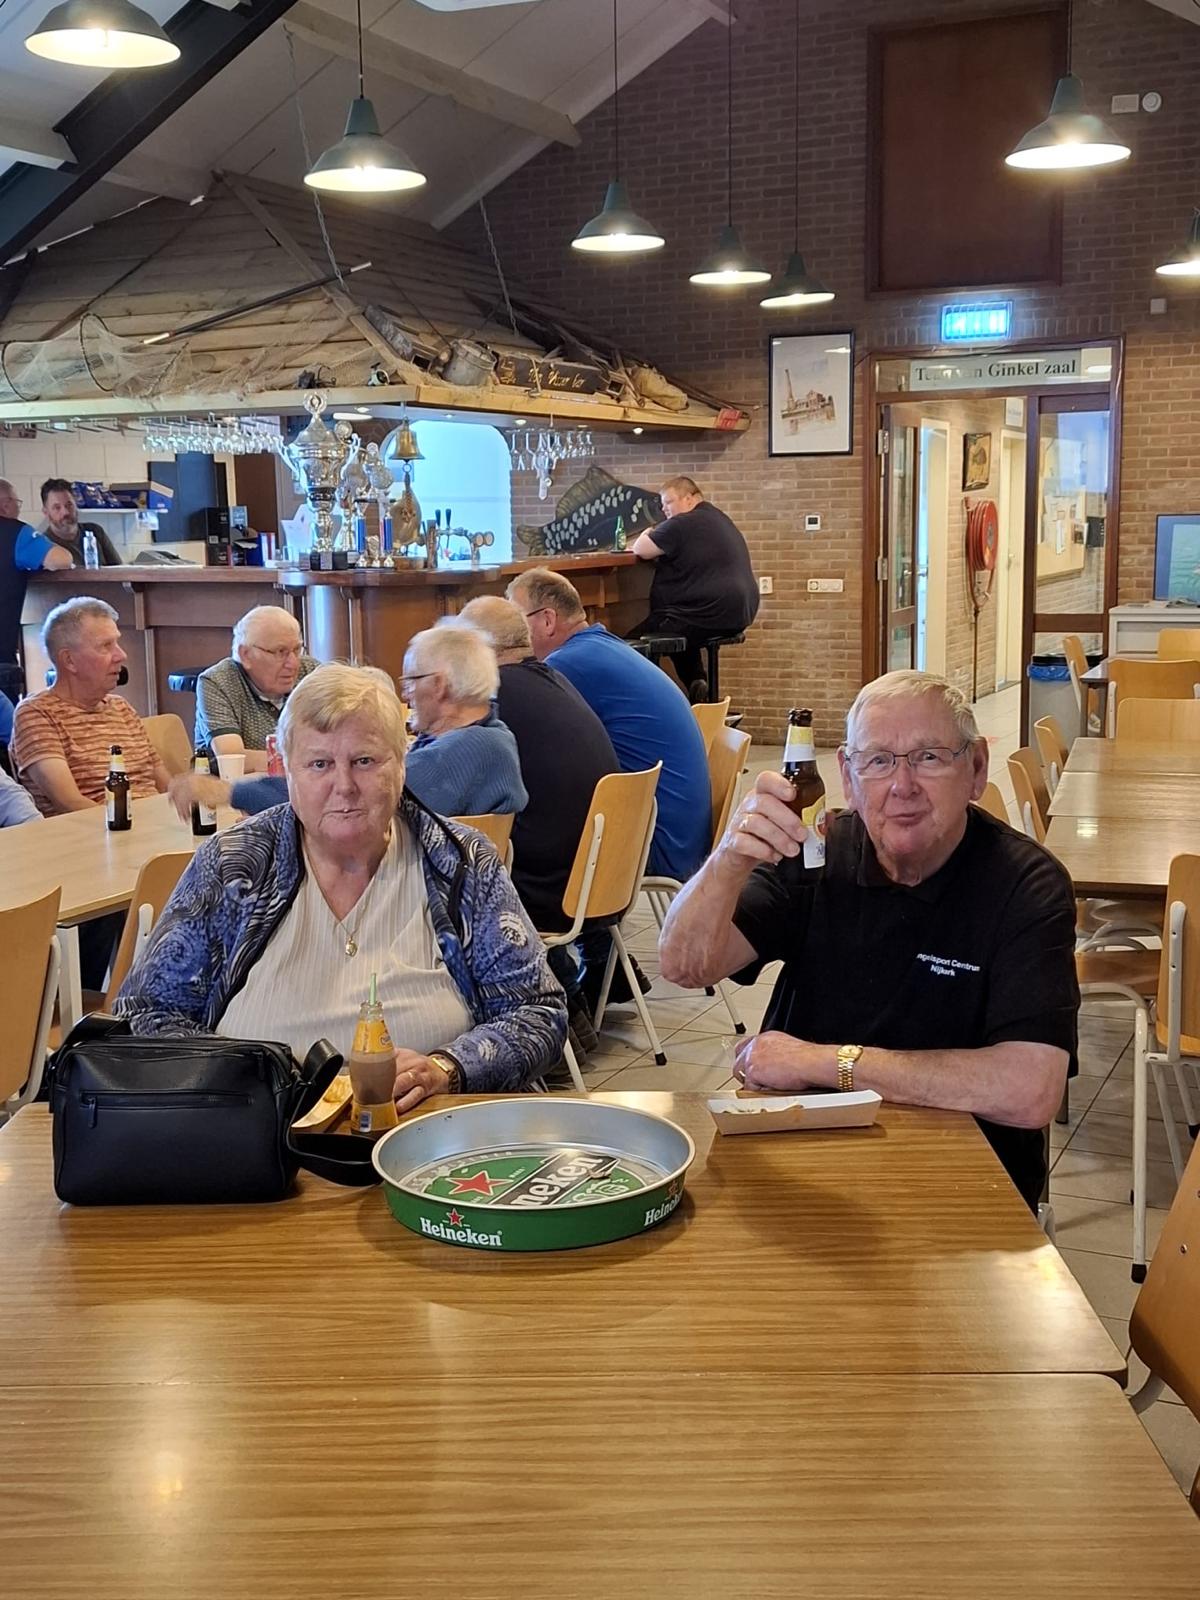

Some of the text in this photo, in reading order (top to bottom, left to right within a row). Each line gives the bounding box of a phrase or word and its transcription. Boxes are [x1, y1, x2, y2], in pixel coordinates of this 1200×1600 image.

[988, 361, 1039, 378] Ginkel
[1044, 359, 1076, 375] zaal
[511, 1156, 604, 1207] neken
[420, 1216, 503, 1246] Heineken
